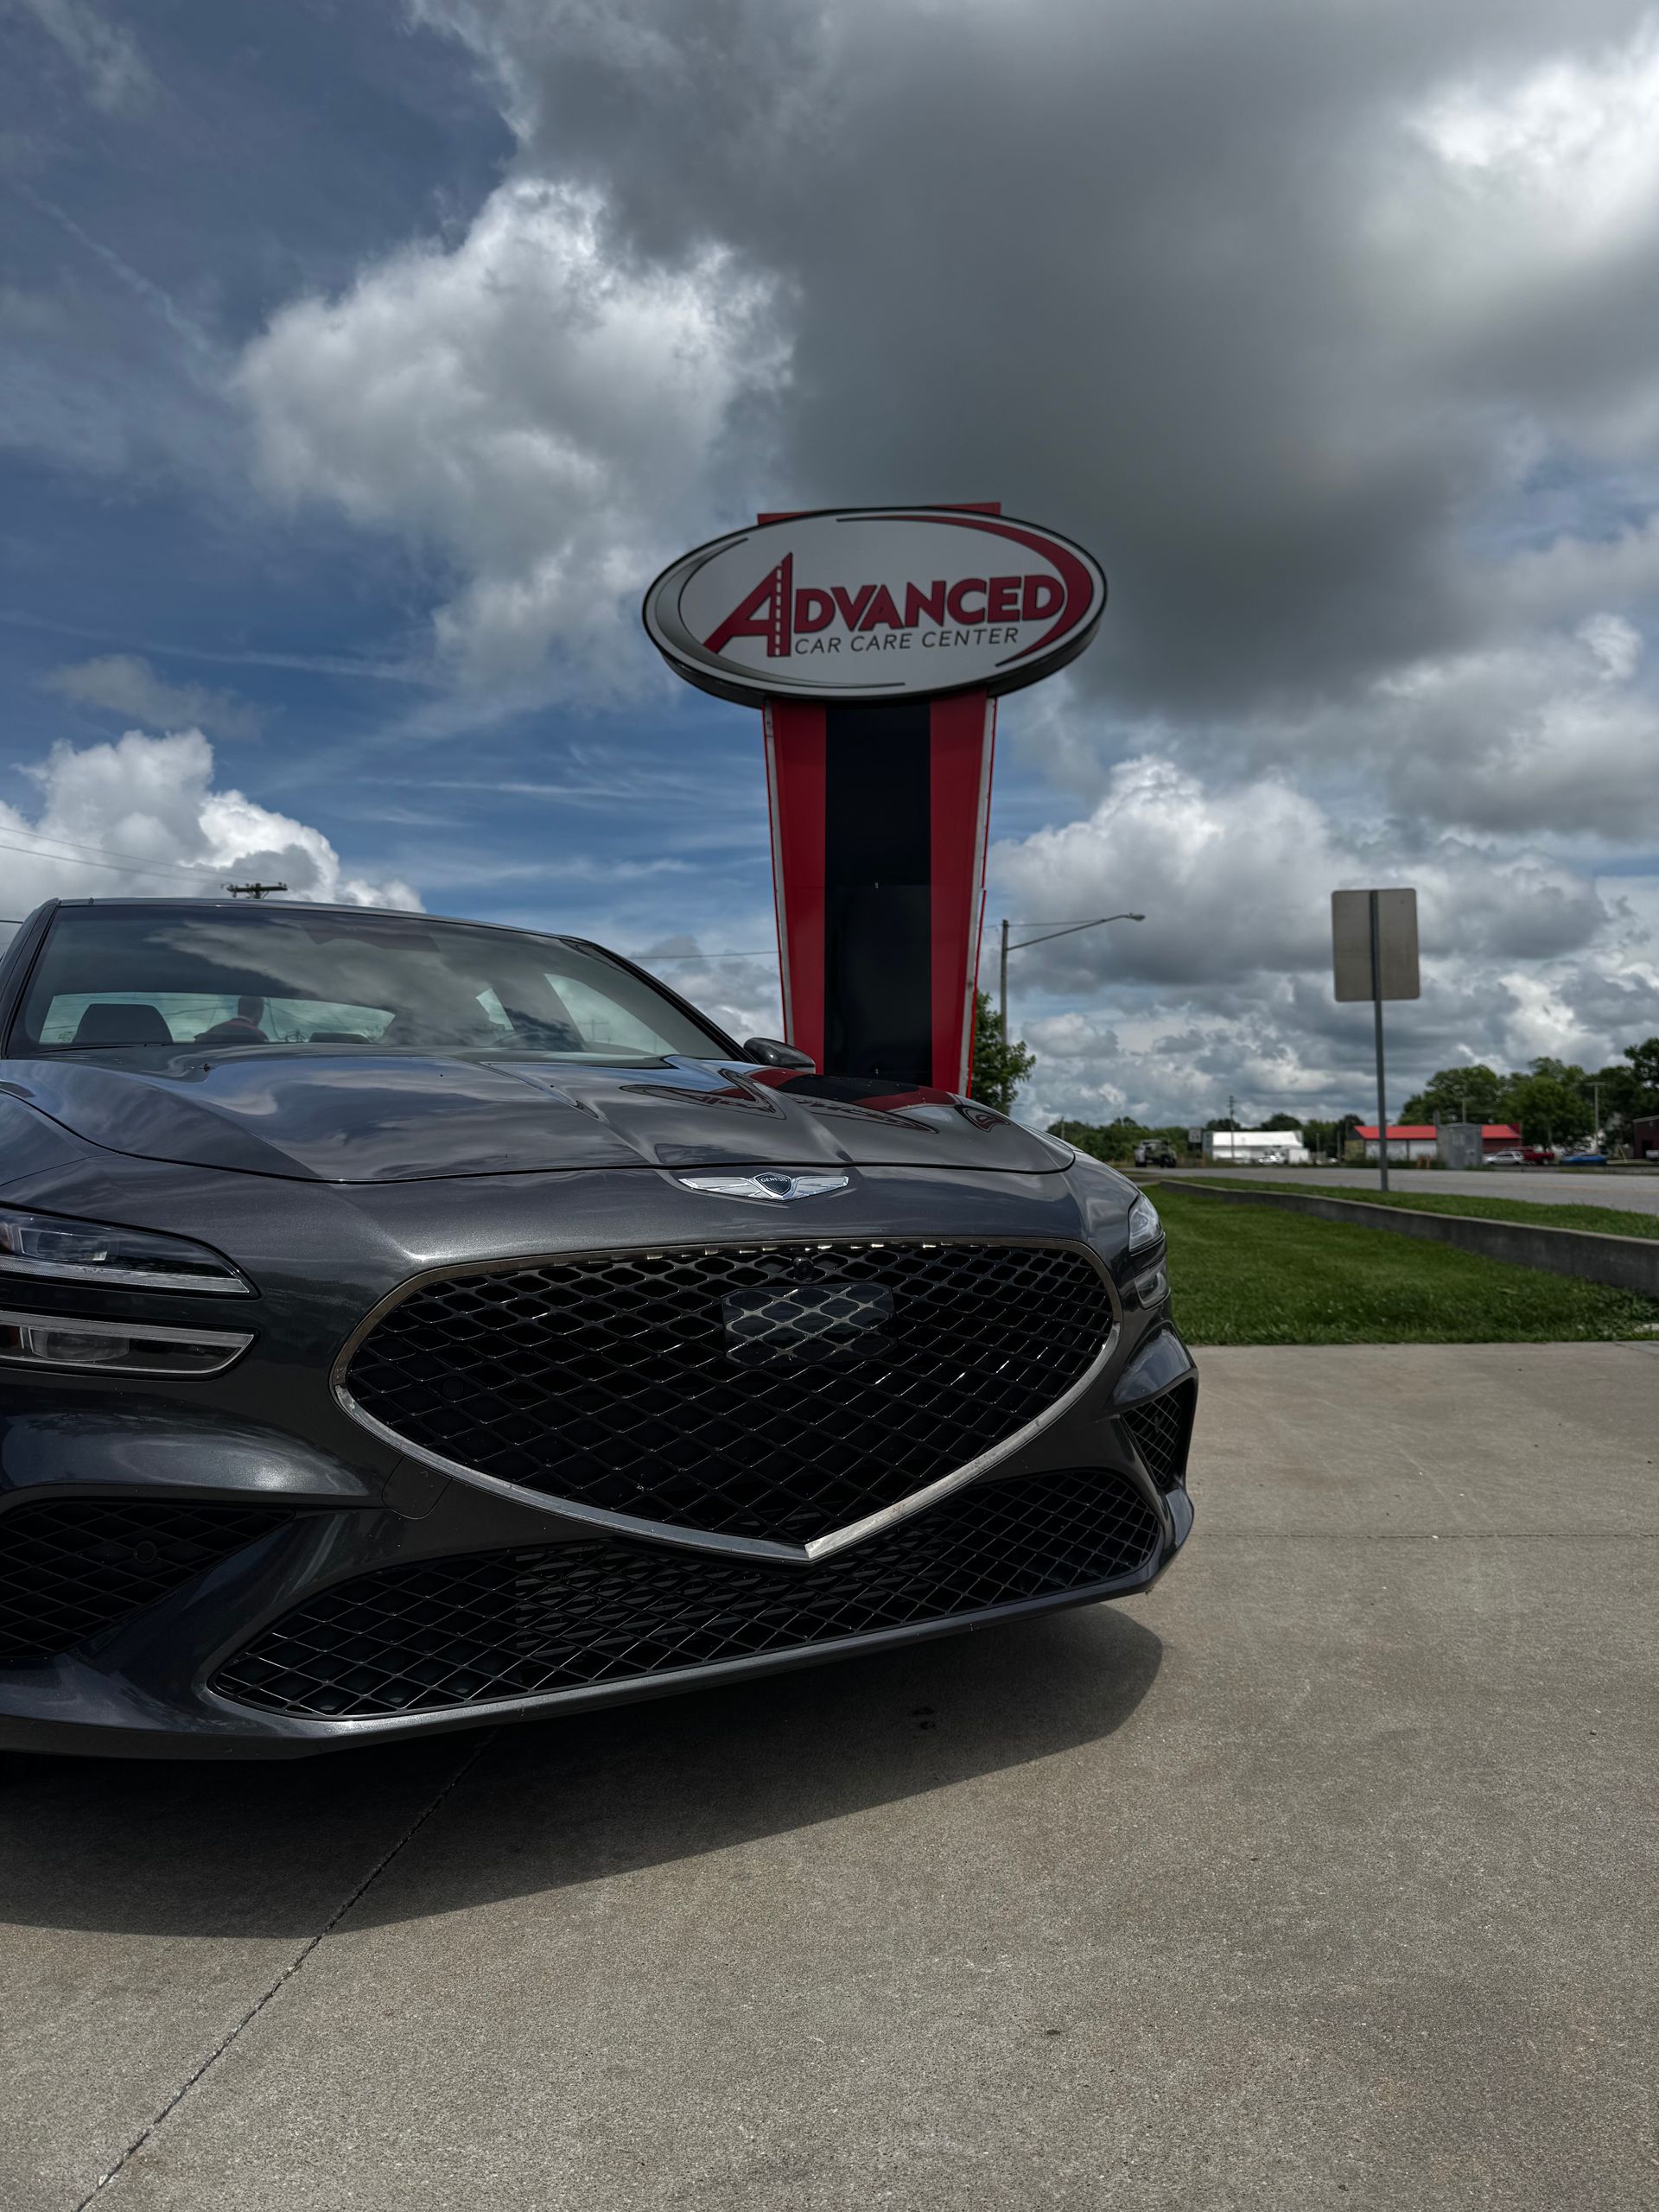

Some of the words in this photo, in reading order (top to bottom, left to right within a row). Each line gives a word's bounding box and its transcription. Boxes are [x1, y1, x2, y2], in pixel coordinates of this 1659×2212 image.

[702, 551, 1065, 658] ADVANCED
[794, 637, 842, 655] CAR
[849, 632, 912, 652] CARE
[921, 627, 1019, 648] CENTER
